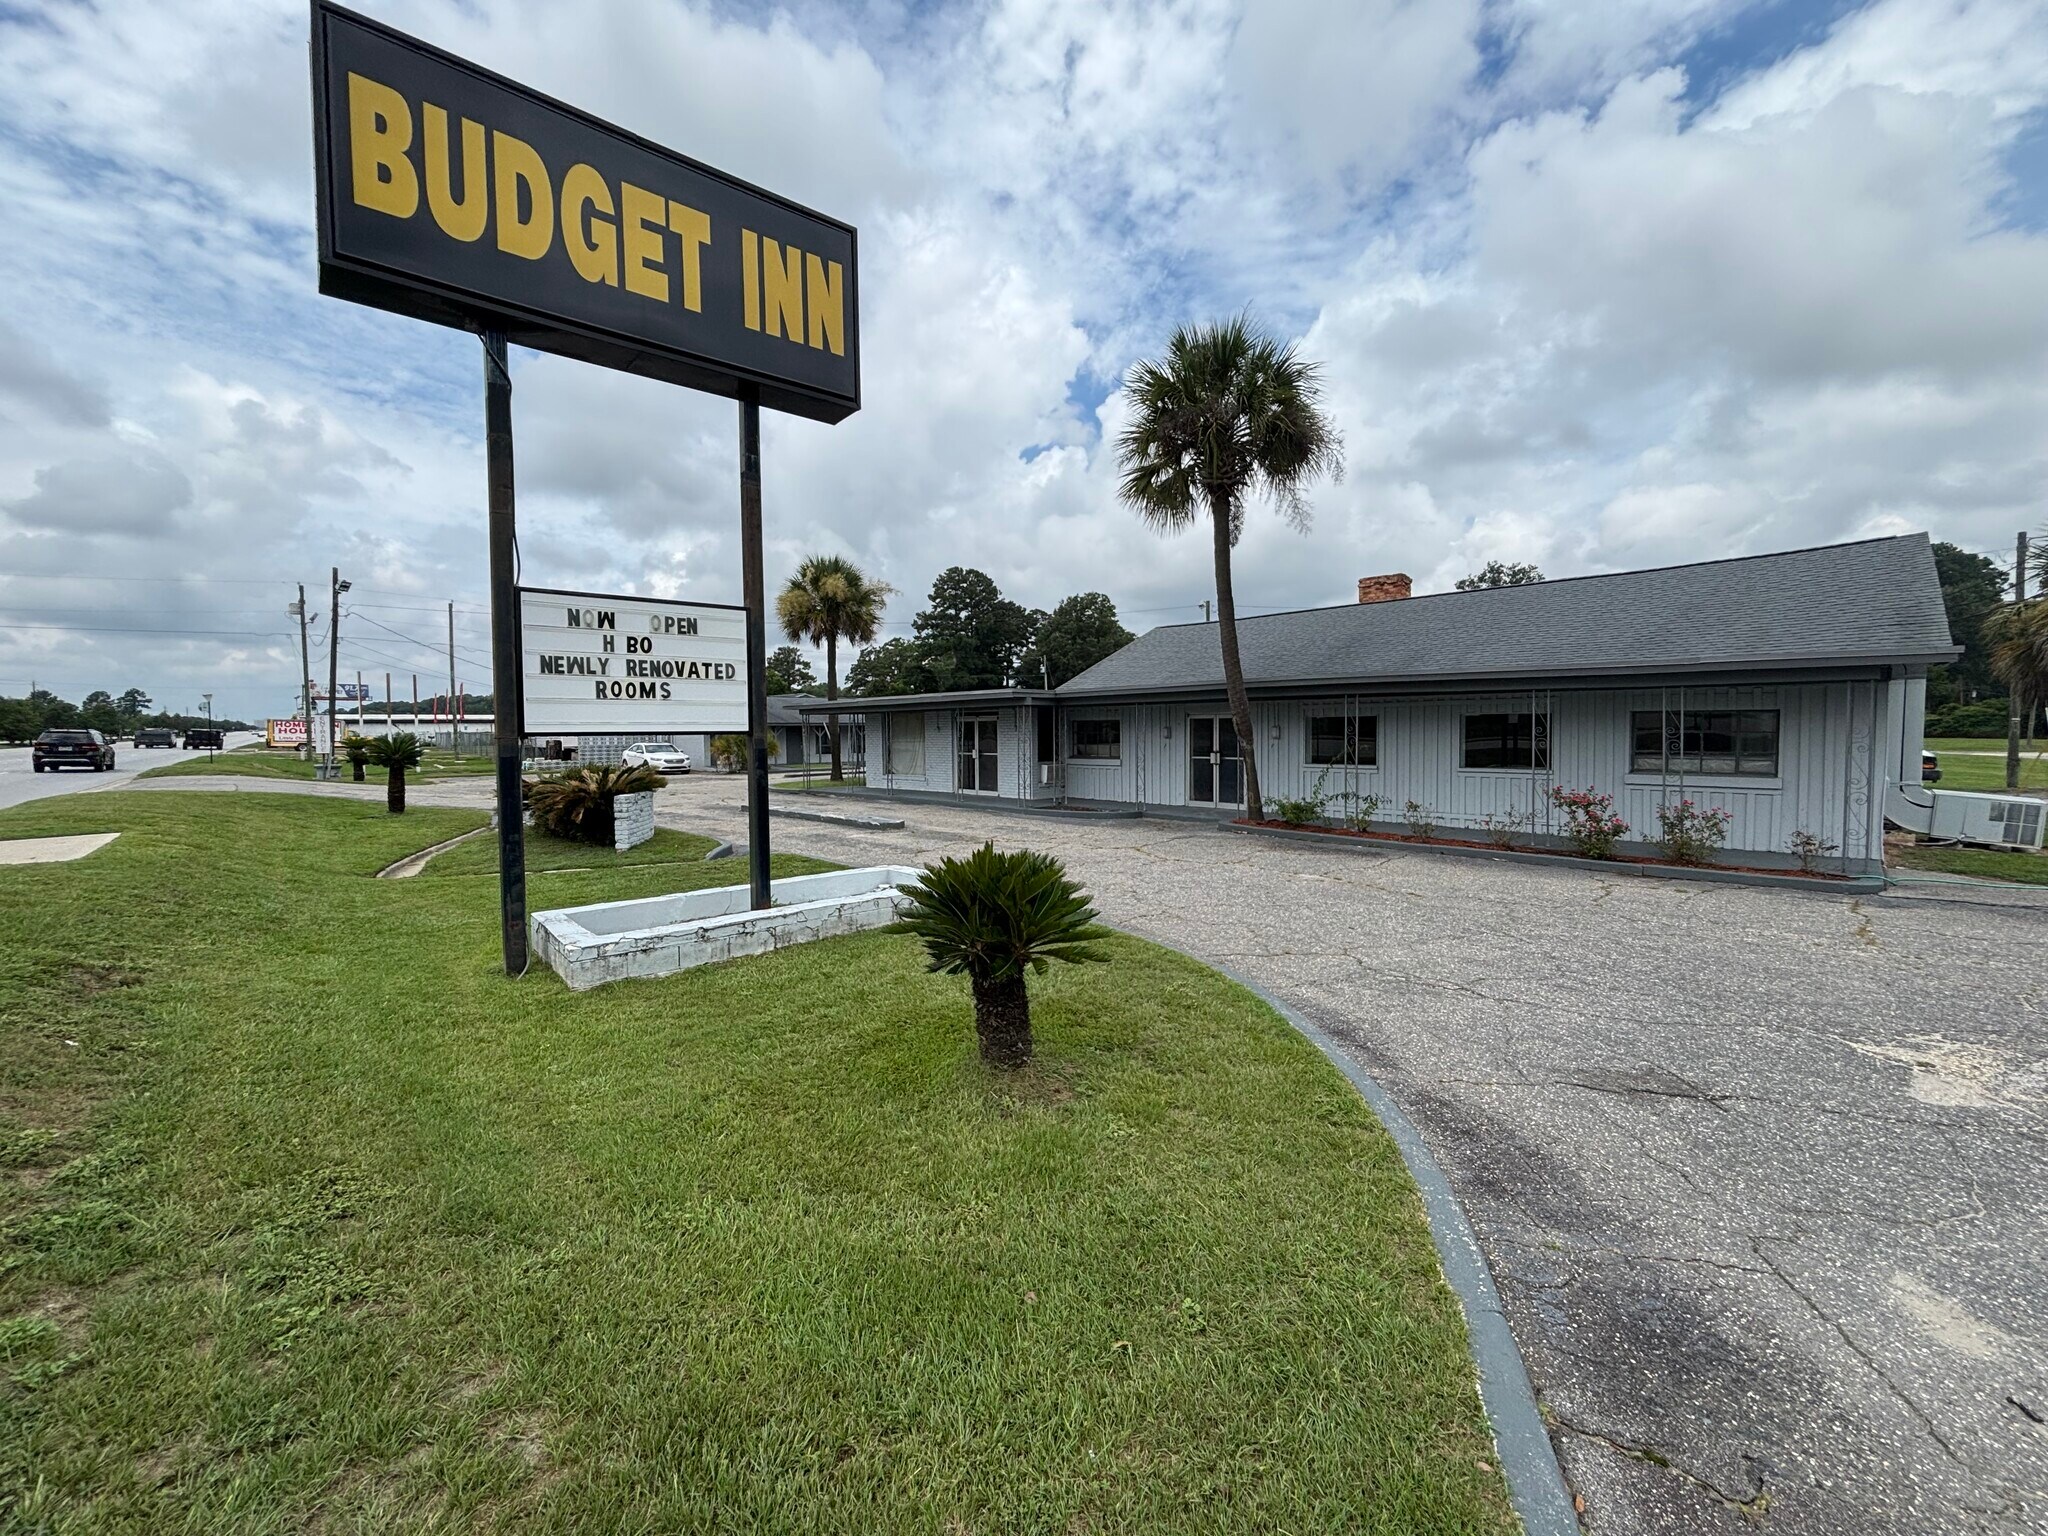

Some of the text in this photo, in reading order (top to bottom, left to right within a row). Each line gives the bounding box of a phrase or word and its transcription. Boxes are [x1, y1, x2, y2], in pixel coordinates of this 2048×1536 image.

[347, 71, 845, 357] BUDGET INN
[566, 608, 698, 635] NOW OPEN
[540, 655, 736, 680] NEWLY RENOVATED
[595, 680, 672, 700] ROOMS
